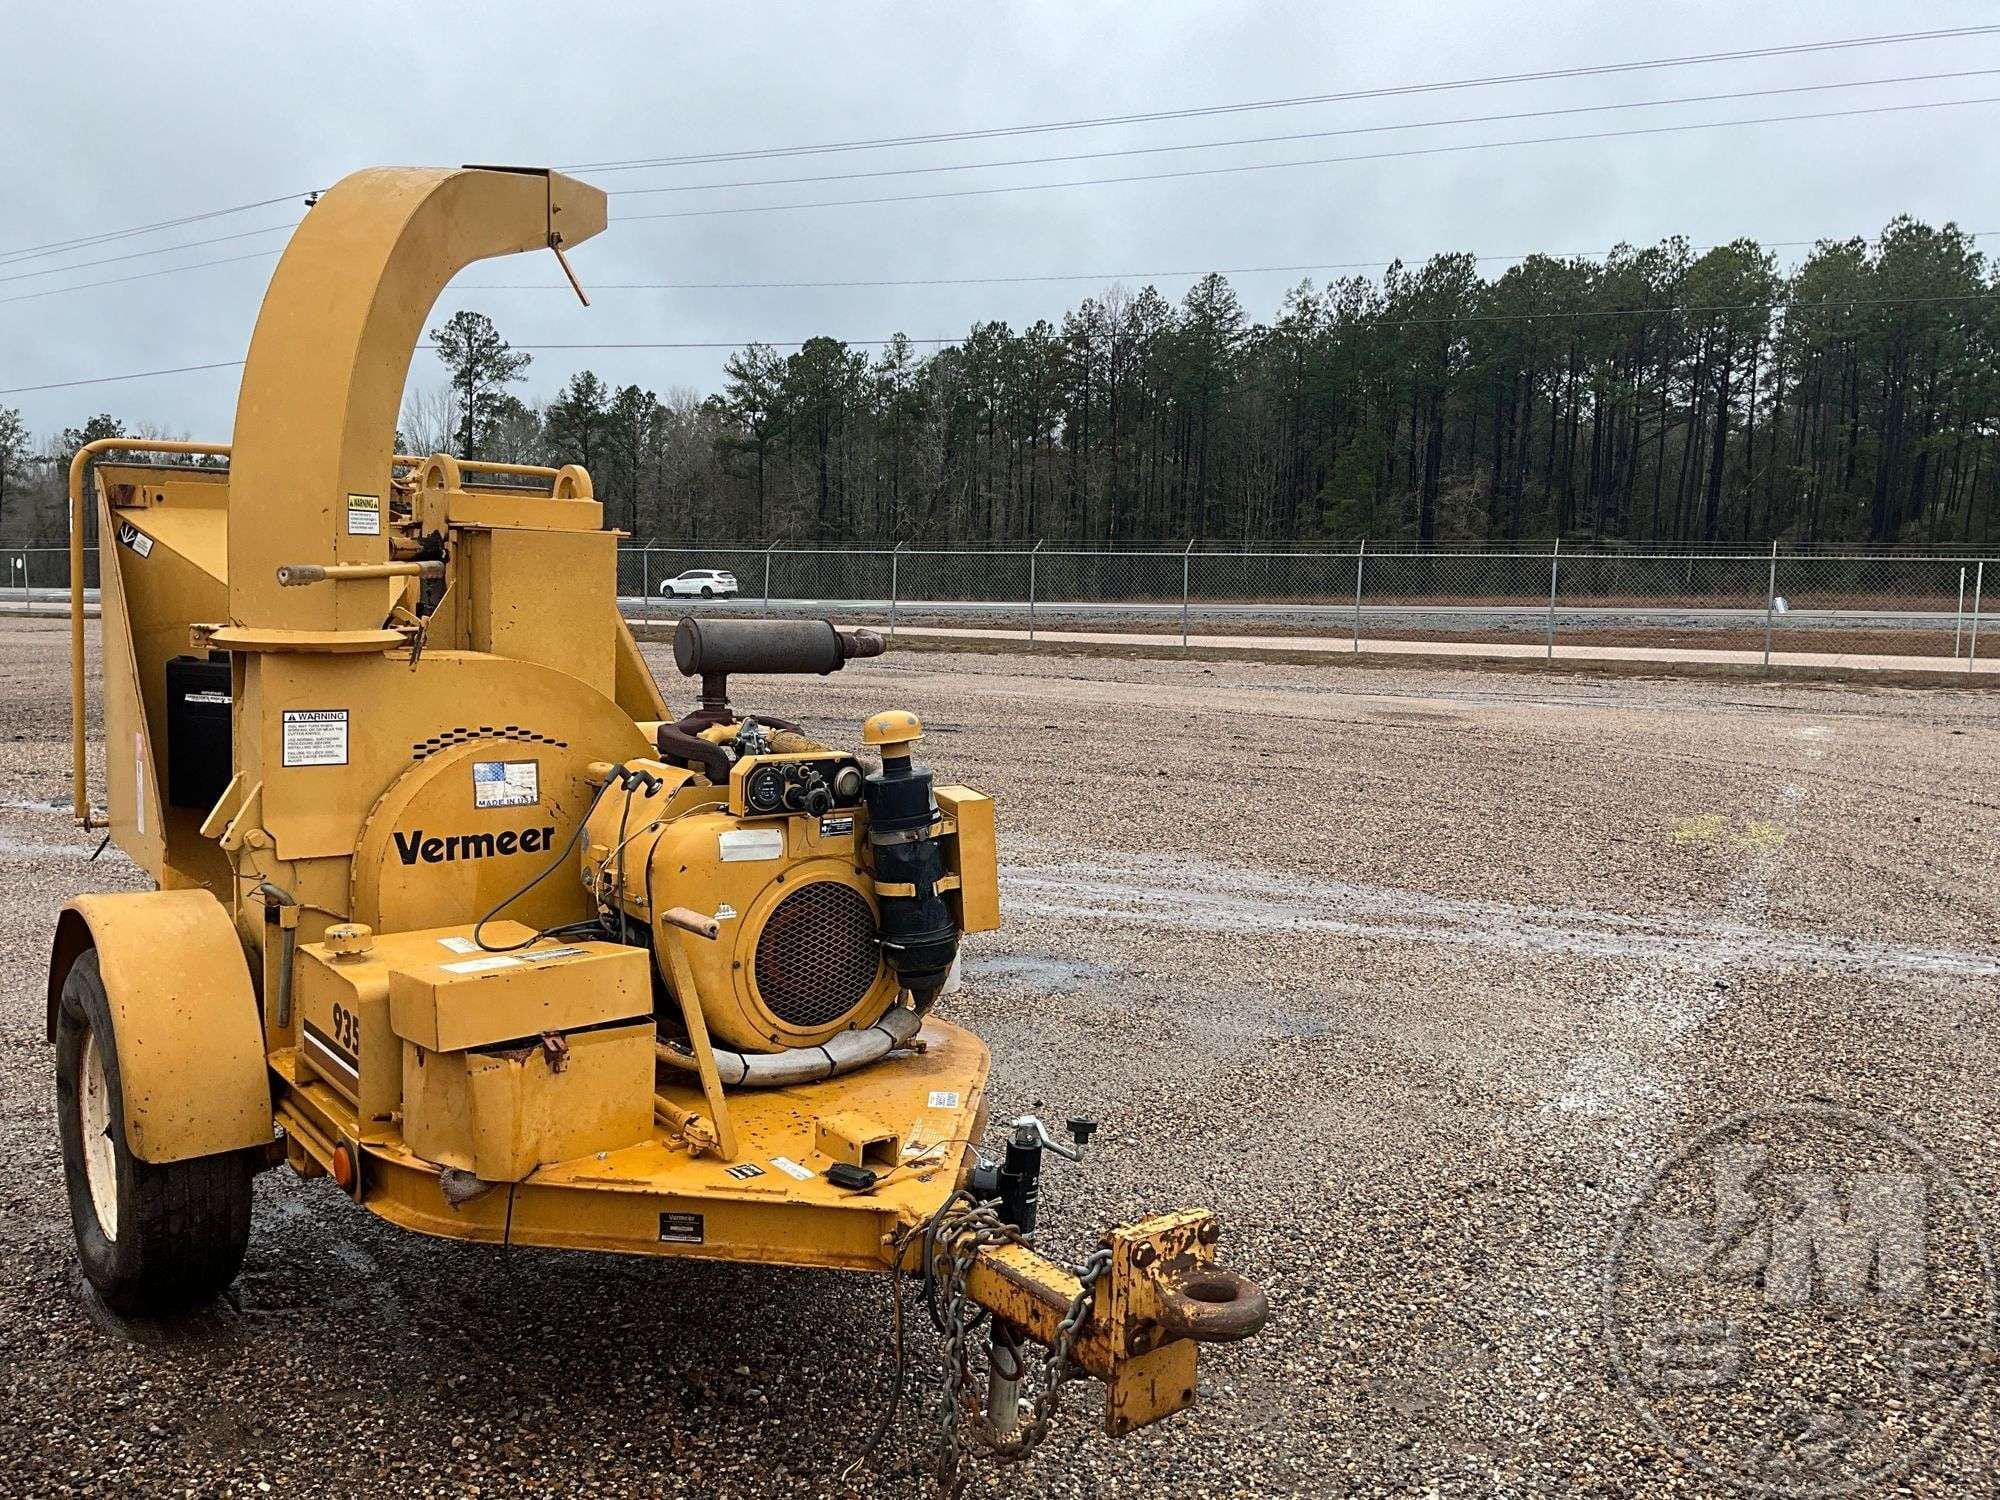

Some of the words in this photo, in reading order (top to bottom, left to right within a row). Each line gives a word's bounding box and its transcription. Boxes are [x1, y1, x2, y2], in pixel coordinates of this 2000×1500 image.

[298, 712, 344, 721] WARNING
[478, 798, 504, 806] MADE
[393, 826, 555, 865] Vermeer
[333, 1002, 359, 1056] 935
